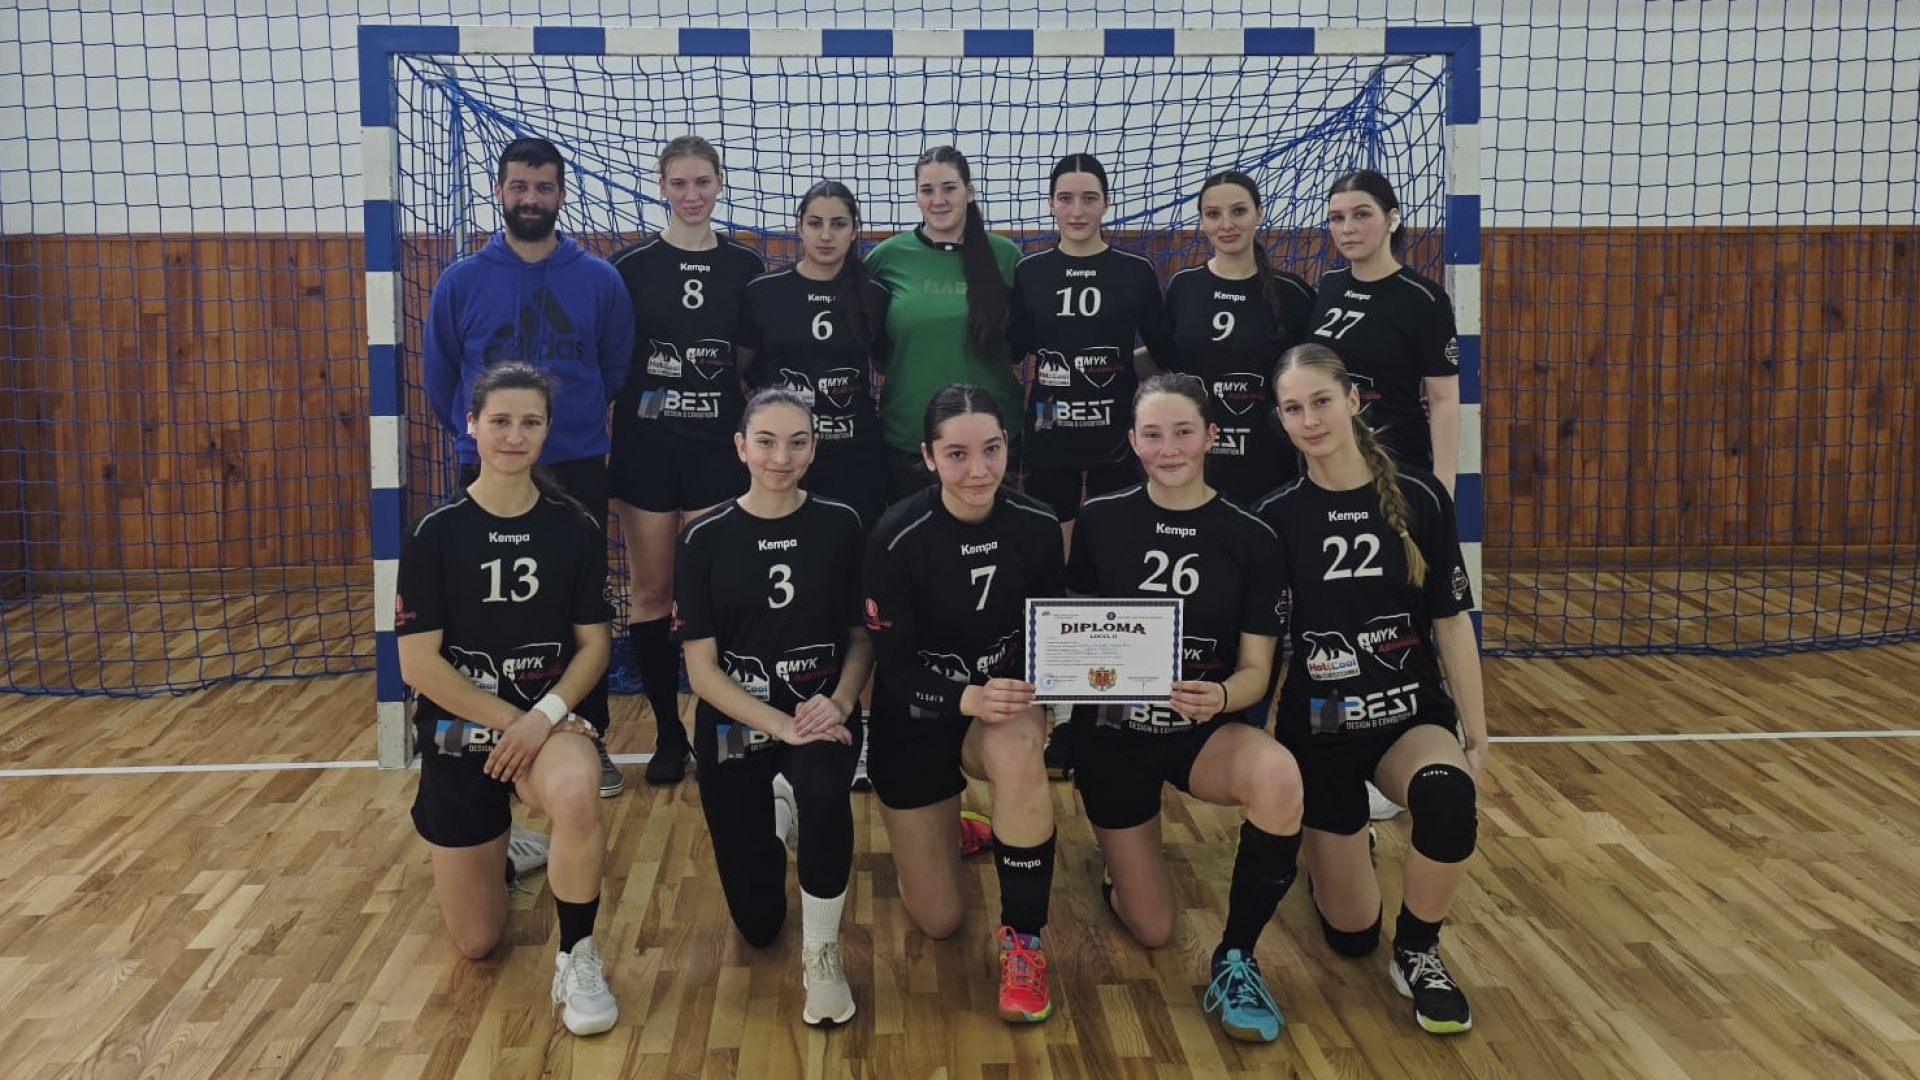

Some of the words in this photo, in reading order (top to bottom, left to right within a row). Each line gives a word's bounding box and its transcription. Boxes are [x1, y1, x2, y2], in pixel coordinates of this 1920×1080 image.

[680, 262, 711, 273] Kempa
[1066, 269, 1097, 279] Kempa
[681, 278, 704, 309] 8
[1056, 287, 1101, 317] 10
[1214, 290, 1246, 301] Kempa
[1343, 290, 1372, 300] Kempa
[811, 310, 833, 340] 6
[1211, 311, 1236, 341] 9
[1314, 308, 1365, 339] 27
[664, 390, 721, 417] BEST
[1057, 399, 1114, 425] BEST
[1328, 510, 1369, 522] Kempa
[489, 532, 530, 545] Kempa
[1156, 523, 1197, 538] Kempa
[758, 538, 798, 550] Kempa
[961, 541, 998, 556] Kempa
[1323, 533, 1383, 581] 22
[480, 557, 540, 602] 13
[1138, 550, 1200, 595] 26
[768, 564, 795, 609] 3
[970, 565, 997, 611] 7
[1060, 623, 1146, 634] DIPLOMA
[1344, 682, 1419, 720] BEST
[1002, 856, 1041, 869] Kempa
